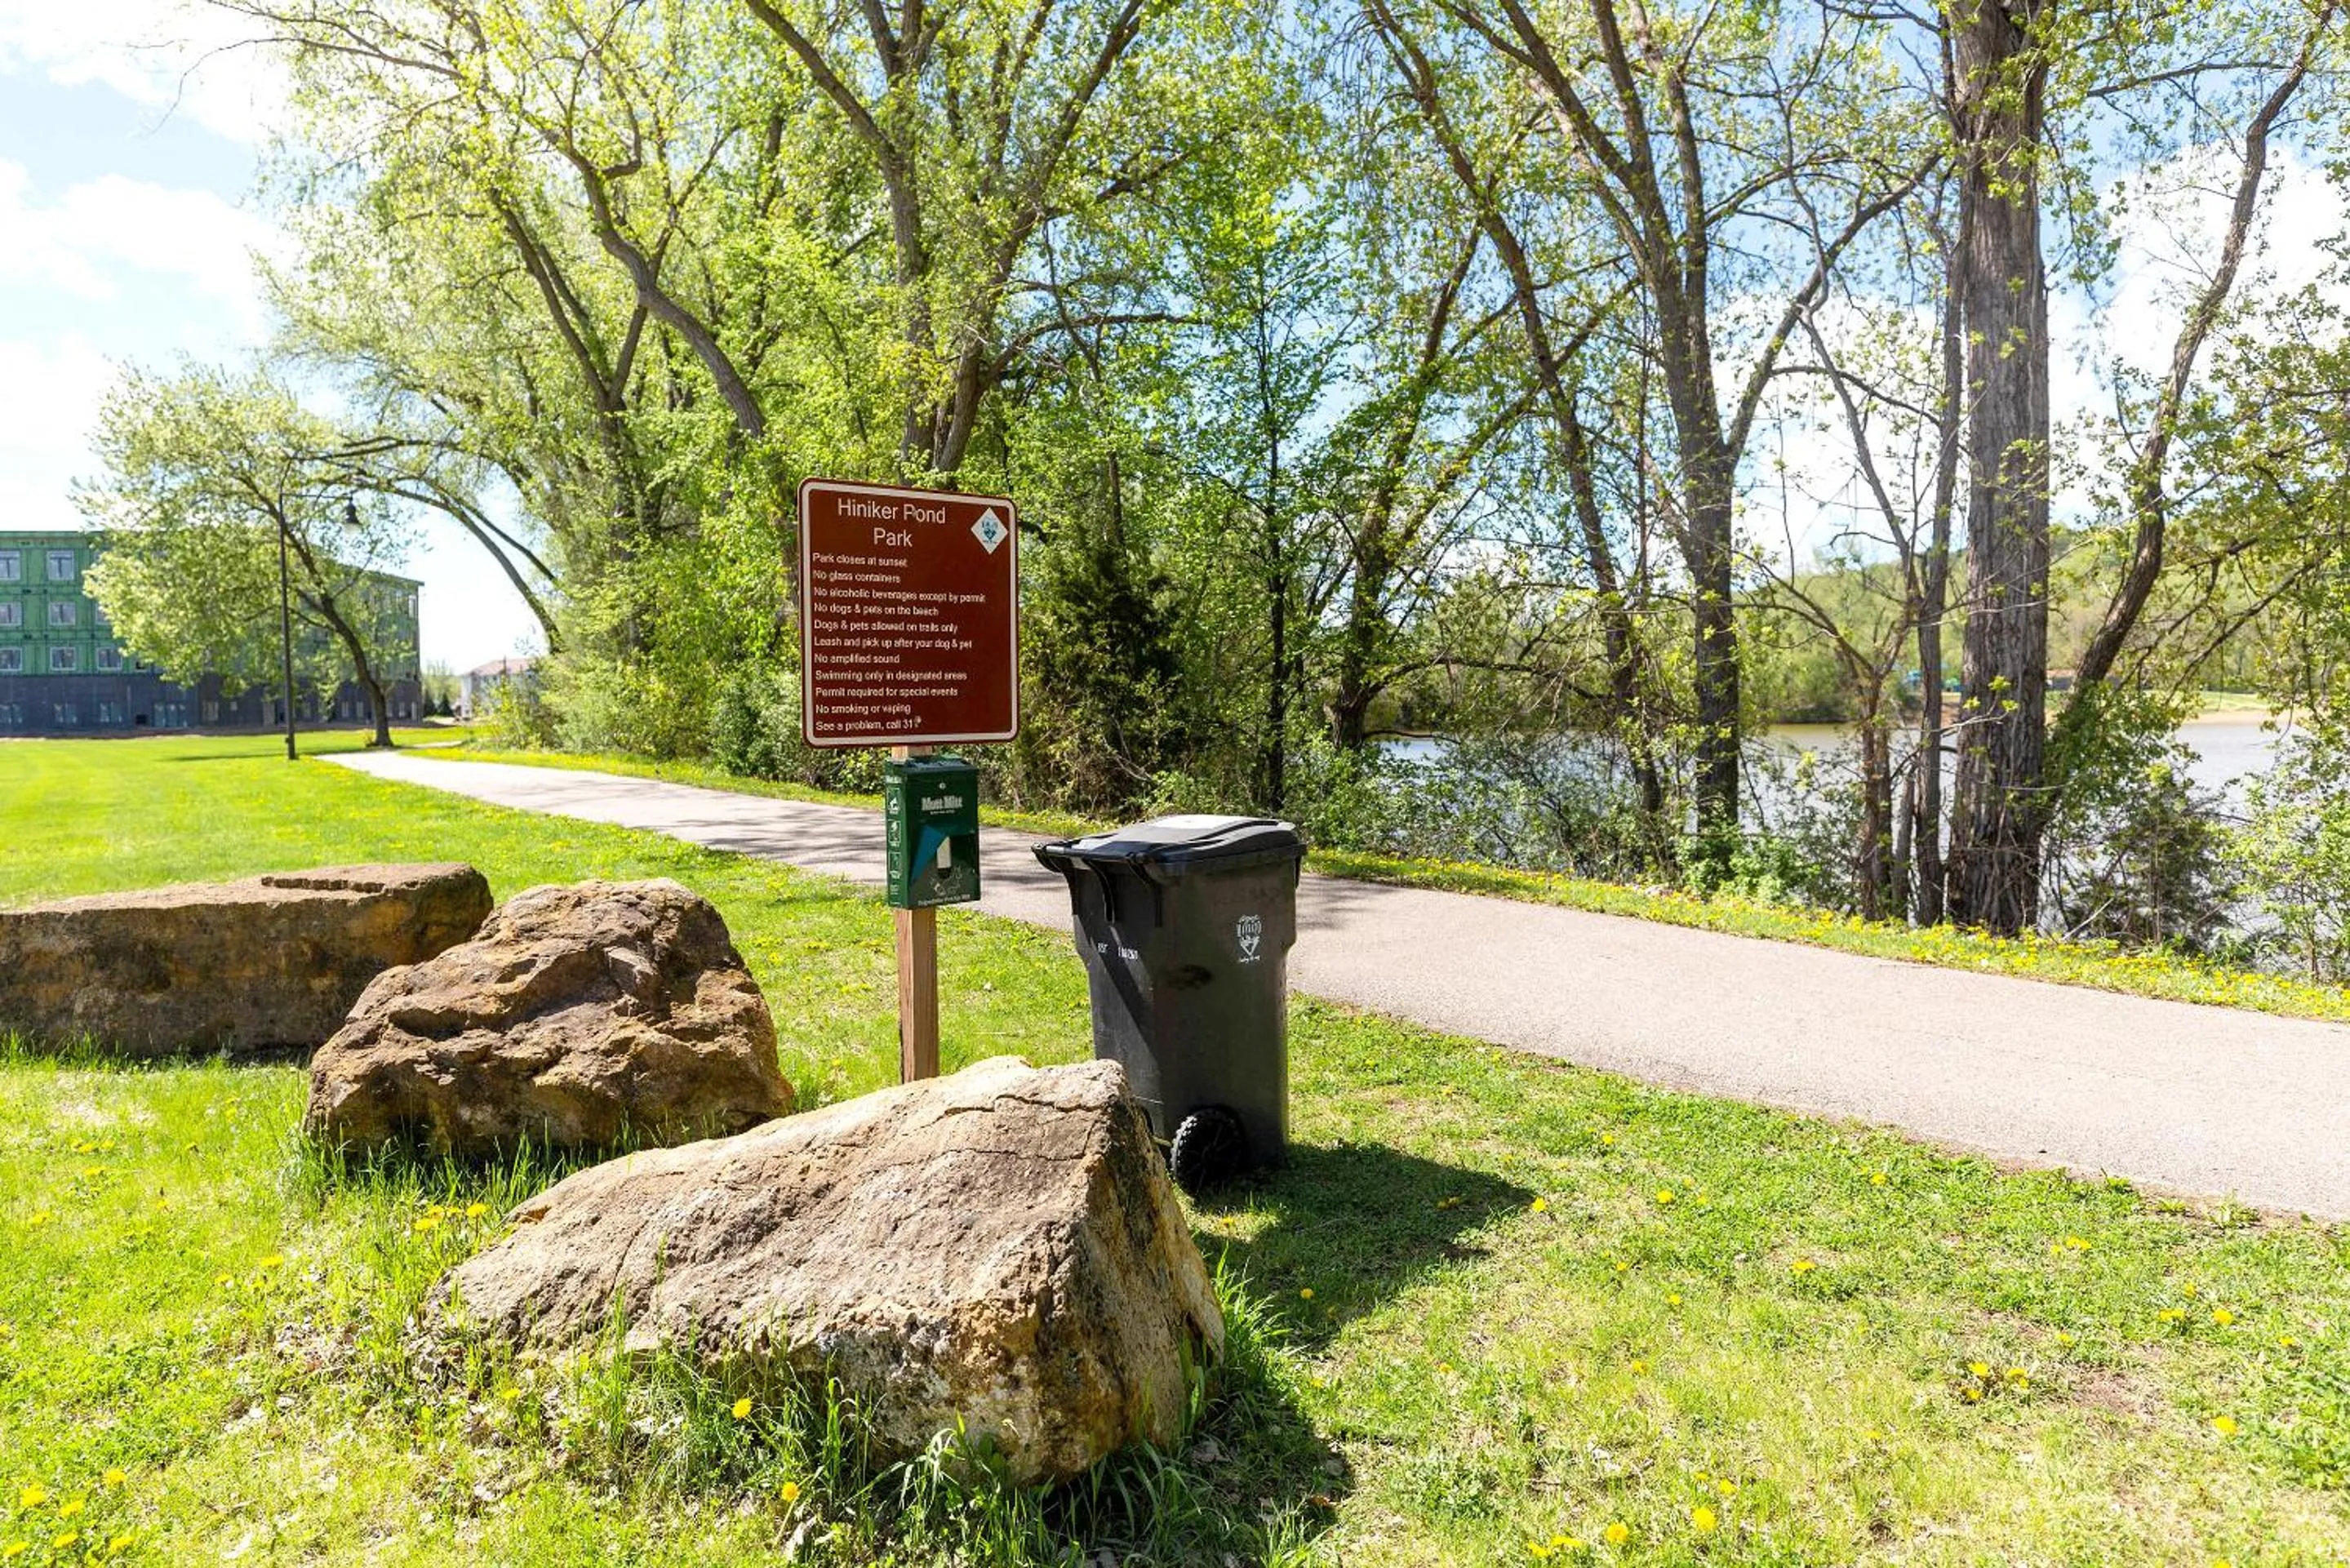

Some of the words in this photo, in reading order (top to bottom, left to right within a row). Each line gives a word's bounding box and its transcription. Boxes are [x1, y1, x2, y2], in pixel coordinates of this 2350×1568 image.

[837, 497, 898, 520] Hiniker
[904, 503, 946, 524] Pond
[873, 527, 913, 547] Park
[812, 553, 834, 563] Park
[836, 554, 865, 565] closes
[867, 556, 877, 566] at
[878, 557, 908, 567] sunset
[813, 570, 827, 580] No
[828, 571, 853, 582] glass
[855, 573, 901, 584] containers
[814, 587, 828, 597] No
[829, 587, 870, 597] alcoholic
[872, 589, 917, 602] beverages
[919, 593, 947, 603] except
[948, 592, 959, 604] by
[960, 593, 987, 604] permit
[814, 602, 828, 612] No
[829, 602, 852, 615] dogs
[854, 603, 861, 614] &
[863, 604, 882, 616] pets
[884, 606, 895, 615] on
[897, 605, 911, 615] the
[913, 606, 940, 616] beach
[814, 620, 839, 633] Dogs
[841, 620, 848, 630] &
[850, 621, 869, 632] pets
[871, 621, 904, 631] allowed
[906, 623, 917, 632] on
[919, 622, 940, 632] trails
[941, 623, 958, 634] only
[814, 637, 842, 646] Leash
[844, 637, 860, 646] and
[862, 637, 880, 649] pick
[882, 639, 892, 649] up
[894, 637, 913, 647] after
[915, 639, 933, 650] your
[935, 638, 950, 651] dog
[951, 638, 958, 648] &
[959, 640, 972, 651] pet
[814, 653, 828, 663] No
[830, 653, 872, 664] amplified
[873, 654, 900, 664] sound
[815, 669, 863, 682] Swimming
[865, 670, 883, 682] only
[886, 670, 894, 680] in
[895, 670, 942, 682] designated
[944, 672, 967, 681] areas
[815, 687, 845, 696] Permit
[847, 687, 884, 699] required
[886, 687, 897, 696] for
[899, 687, 929, 698] special
[931, 687, 958, 696] events
[815, 704, 829, 713] No
[831, 703, 868, 715] smoking
[870, 704, 880, 713] or
[882, 703, 911, 715] vaping
[815, 721, 834, 731] See
[837, 722, 843, 731] a
[845, 720, 884, 732] problem,
[886, 720, 901, 729] call
